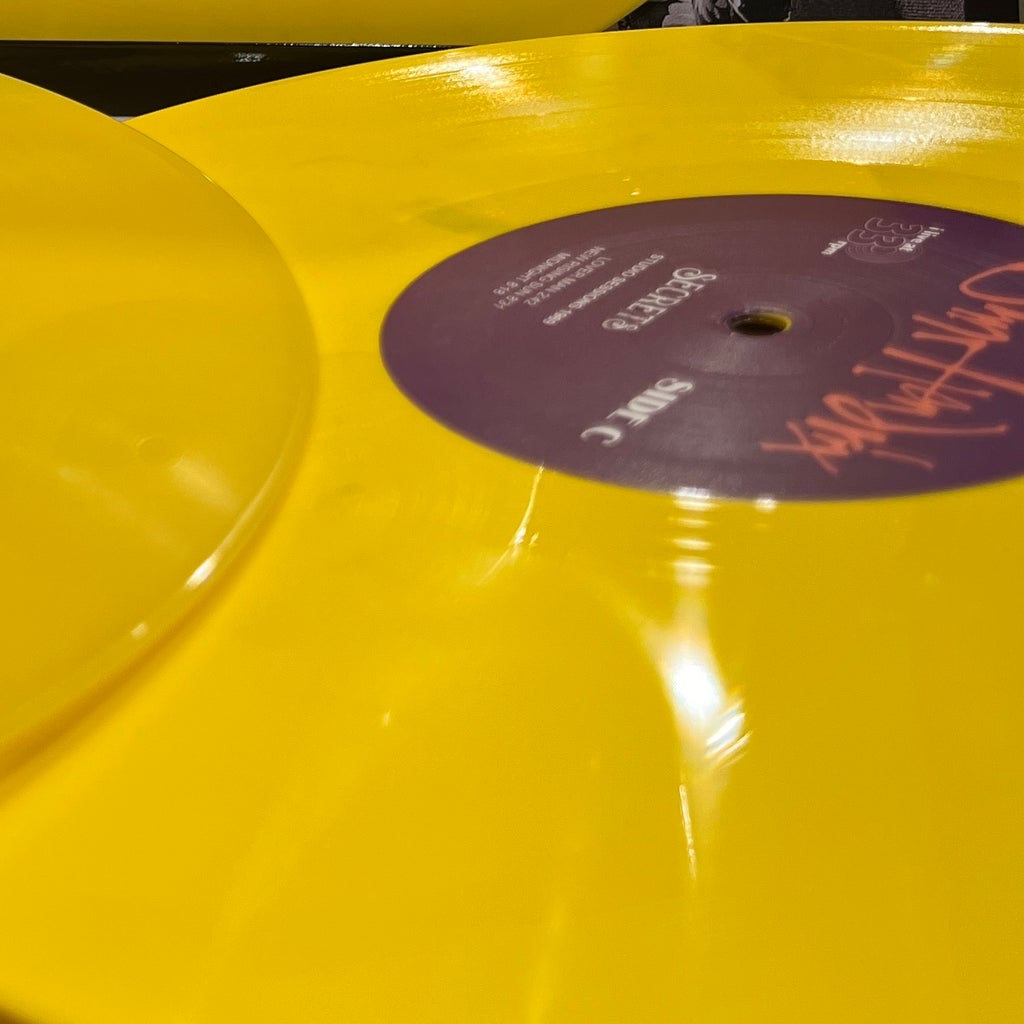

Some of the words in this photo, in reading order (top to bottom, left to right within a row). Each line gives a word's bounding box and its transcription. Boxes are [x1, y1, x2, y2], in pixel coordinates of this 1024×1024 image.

[622, 253, 664, 277] STUDIO
[568, 276, 626, 309] SESSIONS
[602, 267, 717, 331] SECRETS
[606, 377, 695, 427] SIDE
[580, 427, 624, 447] C
